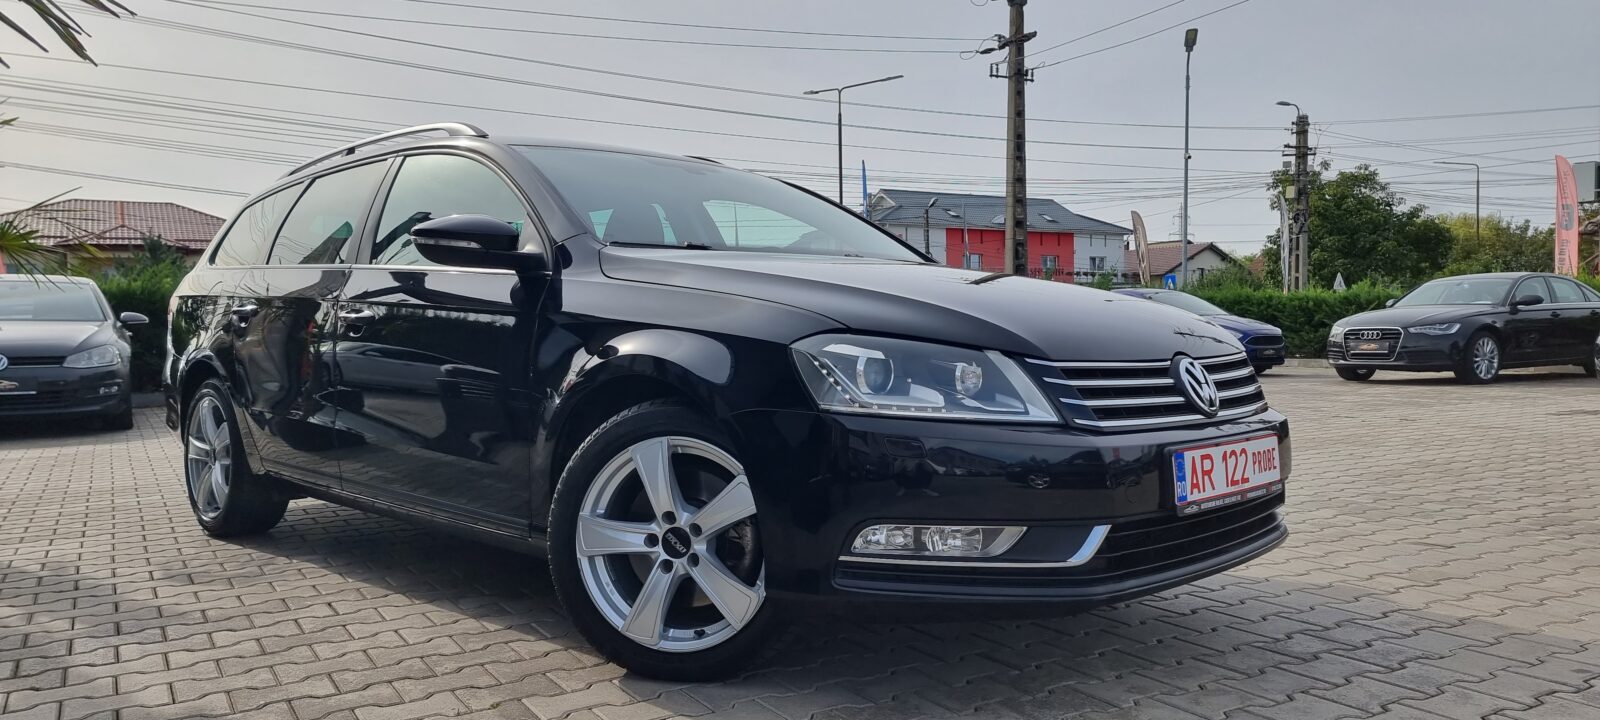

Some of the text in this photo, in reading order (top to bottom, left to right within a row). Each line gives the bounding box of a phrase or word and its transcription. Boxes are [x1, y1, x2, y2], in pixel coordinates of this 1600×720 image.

[1190, 447, 1277, 495] AR 122 PROBE
[1177, 481, 1187, 498] RO
